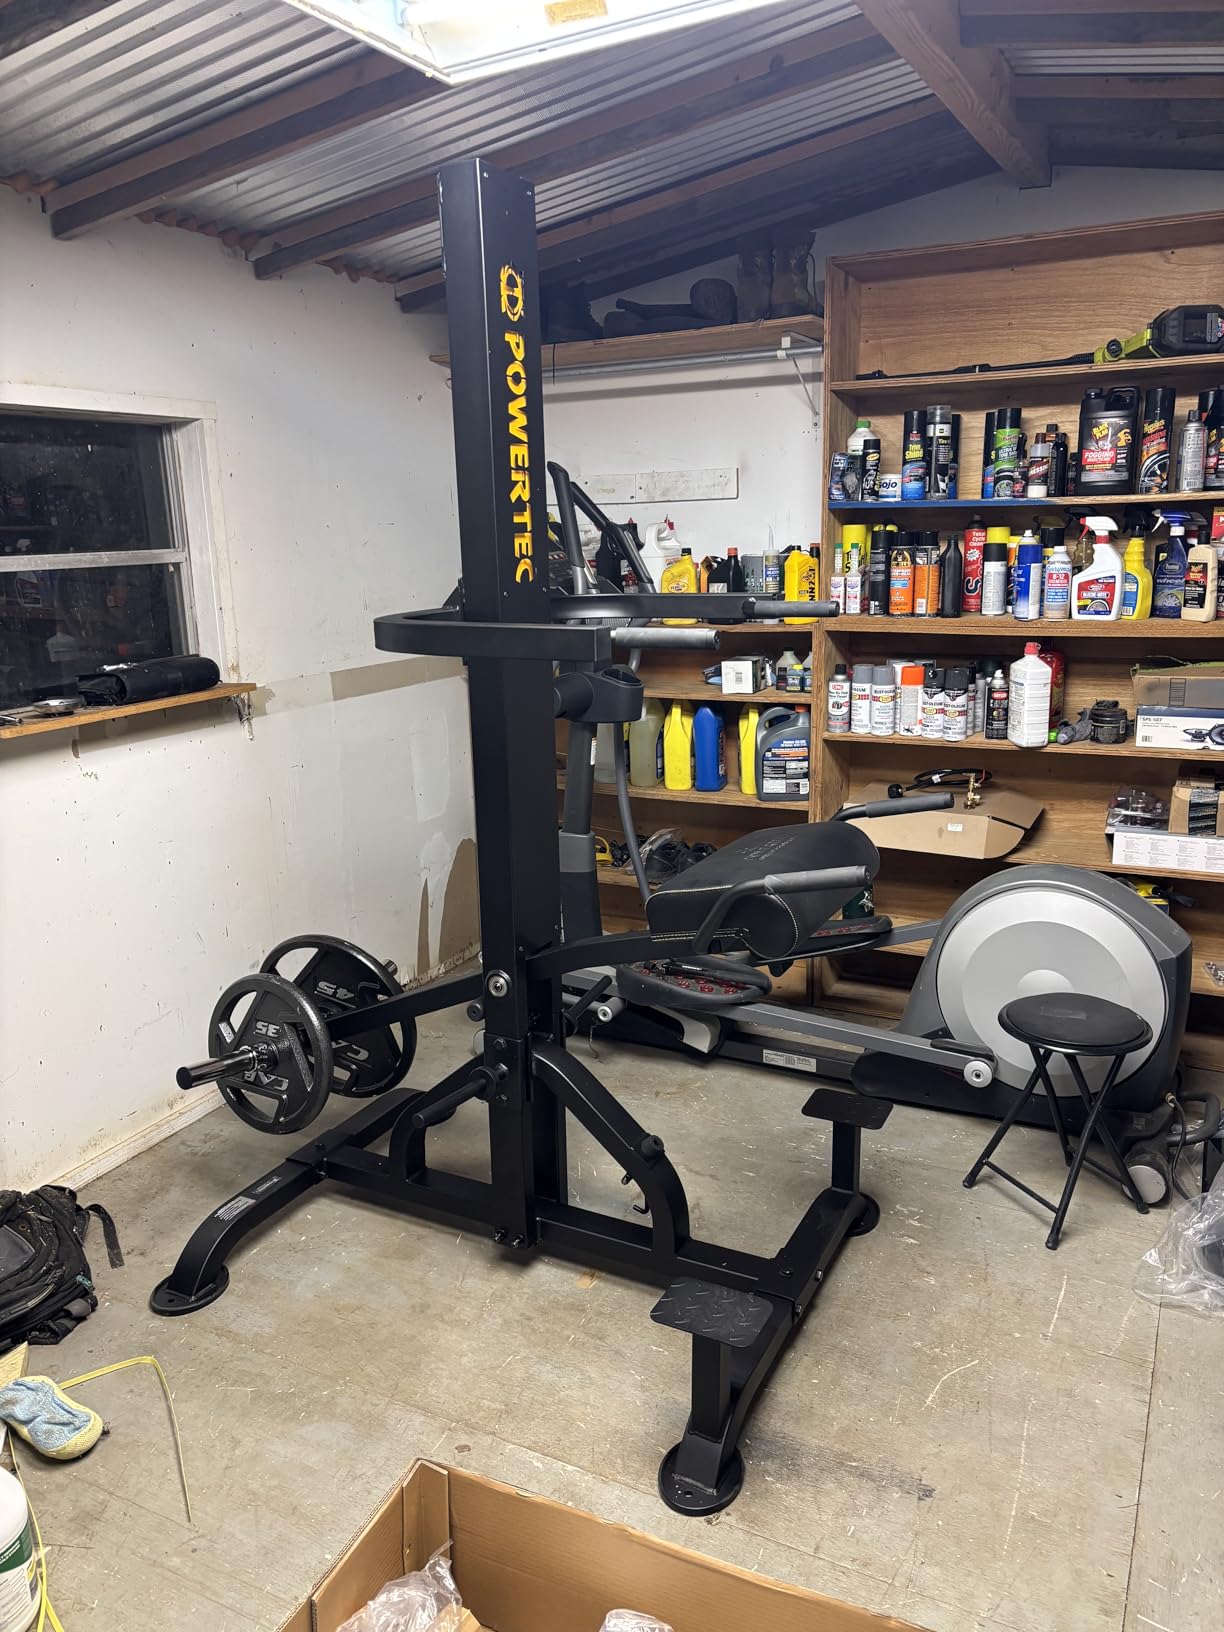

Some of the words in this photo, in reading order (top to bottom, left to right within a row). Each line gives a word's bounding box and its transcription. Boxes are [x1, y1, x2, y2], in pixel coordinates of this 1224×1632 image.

[504, 330, 534, 584] POWERTEC
[1085, 450, 1114, 458] FOGGING
[317, 981, 355, 1000] 45
[255, 1021, 280, 1038] 35
[244, 1069, 289, 1091] CAP
